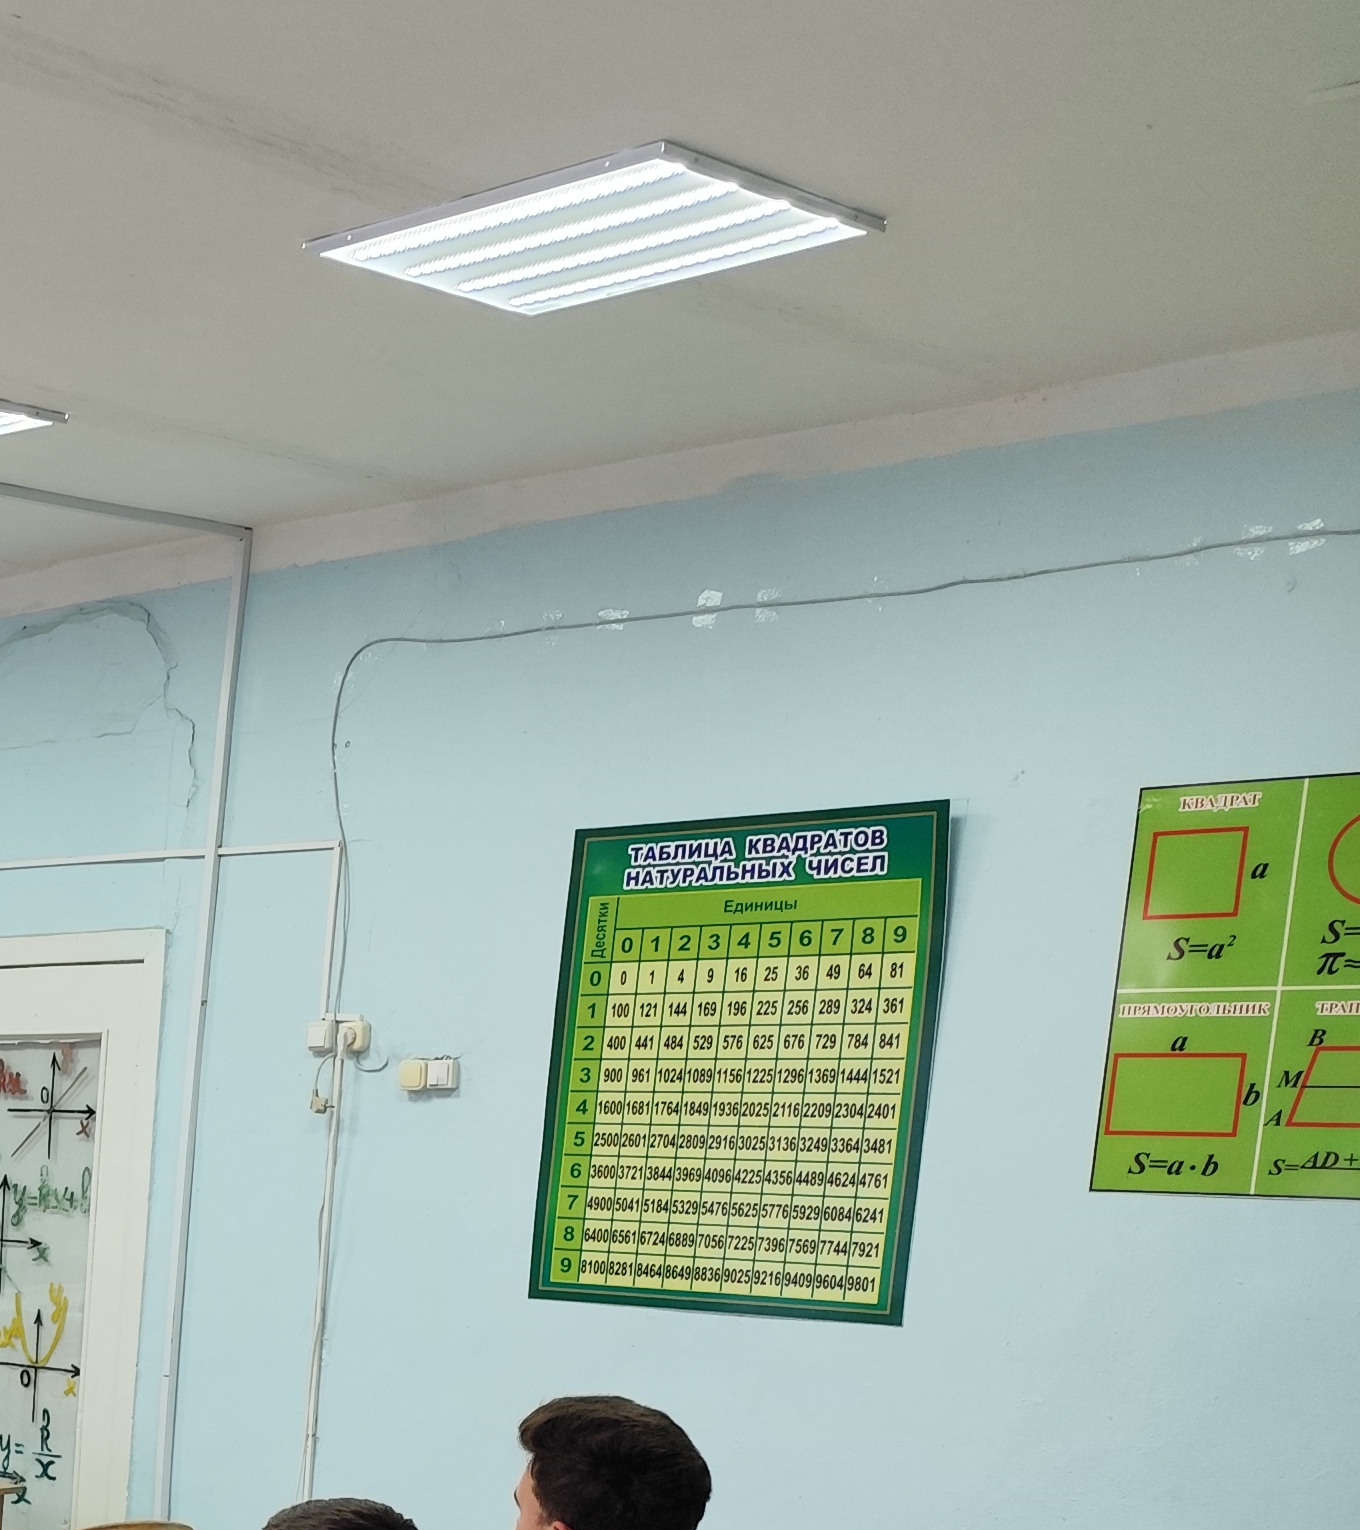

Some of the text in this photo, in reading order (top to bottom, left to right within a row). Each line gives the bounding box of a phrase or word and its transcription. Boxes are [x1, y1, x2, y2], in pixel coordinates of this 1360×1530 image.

[1182, 794, 1261, 811] КВАДРАТ
[630, 829, 885, 863] ТАБЛИЦА КВАДРАТОВ
[625, 855, 887, 887] НАТУРАЛЬНЫХ ЧИСЕЛ
[722, 898, 798, 916] Единицы
[590, 901, 610, 959] Десятки
[621, 925, 907, 953] 0 1 2 3 4 5 6 7 8 9
[589, 961, 904, 986] 0 0 1 4 9 16 25 36 49 64 81
[587, 997, 904, 1019] 1 100 121 144 169 196 225 256 289 324 361
[1120, 1003, 1269, 1017] ПРЯМОУГОЛЬНИК
[581, 1032, 900, 1051] 2 400 441 484 529 576 625 676 729 784 841
[579, 1067, 900, 1084] 3 900 961 1024 1089 1156 1225 1296 1369 1444 1521
[575, 1098, 896, 1119] 4 1600 1681 1764 1849 1936 2025 2116 2209 2304 2401
[573, 1130, 892, 1154] 5 2500 2601 2704 2809 2916 3025 3136 3249 3364 3481
[569, 1162, 581, 1178] 6
[567, 1193, 579, 1210] 7
[562, 1225, 574, 1241] 8
[560, 1257, 875, 1292] 9 8100 8281 8464 8649 8836 9025 9216 9409 9604 9801
